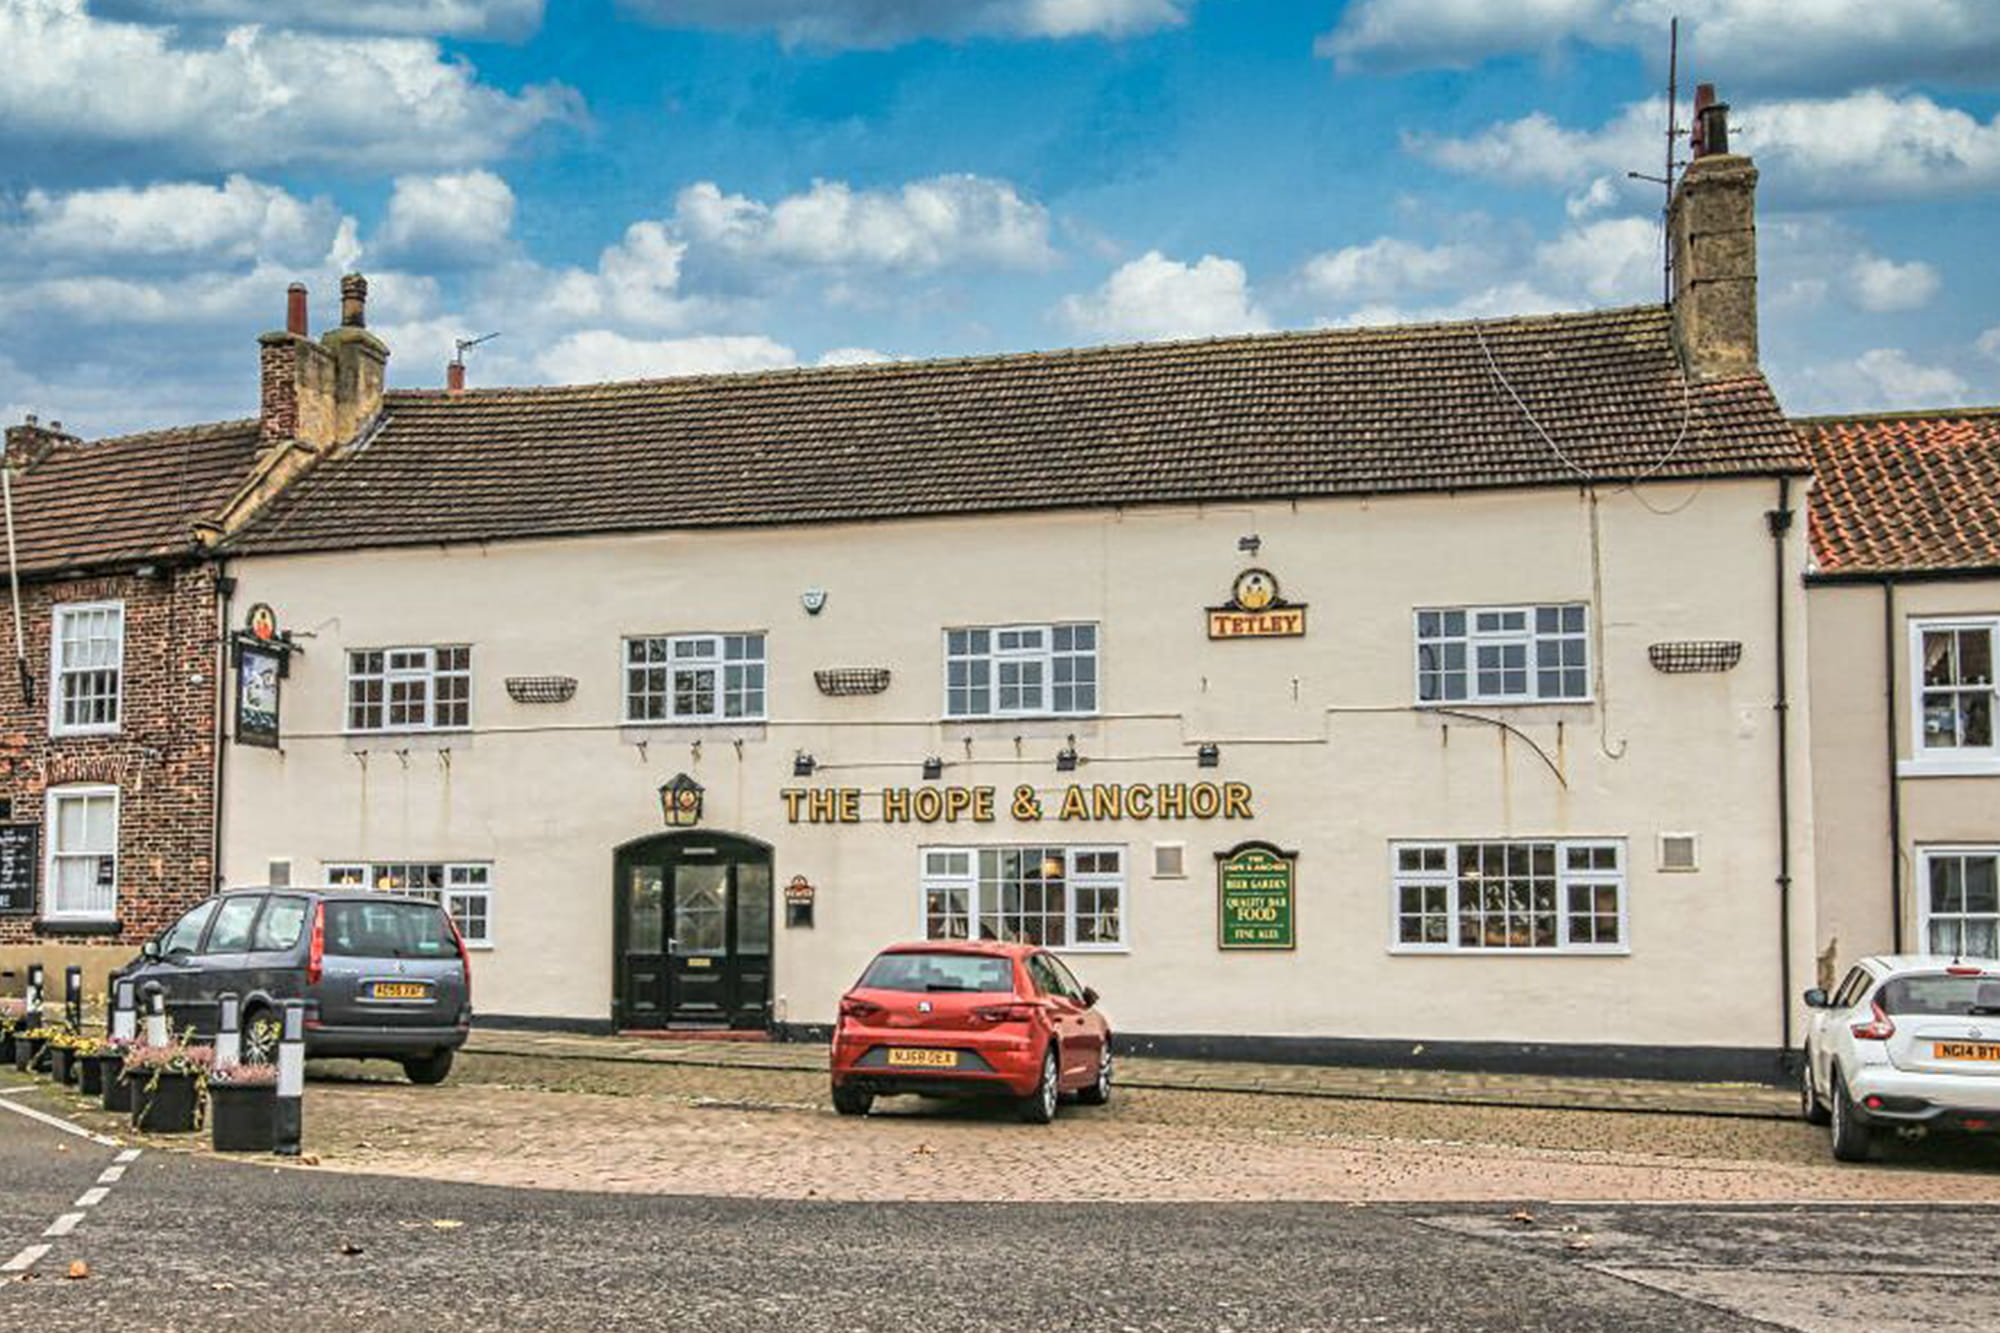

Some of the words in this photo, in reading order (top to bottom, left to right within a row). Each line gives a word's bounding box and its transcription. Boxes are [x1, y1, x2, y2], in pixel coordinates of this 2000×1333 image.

[1214, 615, 1298, 634] TETLEY
[780, 788, 861, 823] THE
[882, 787, 996, 822] HOPE
[1010, 785, 1042, 821] &
[1059, 783, 1254, 821] ANCHOR
[1237, 907, 1277, 921] FOOD
